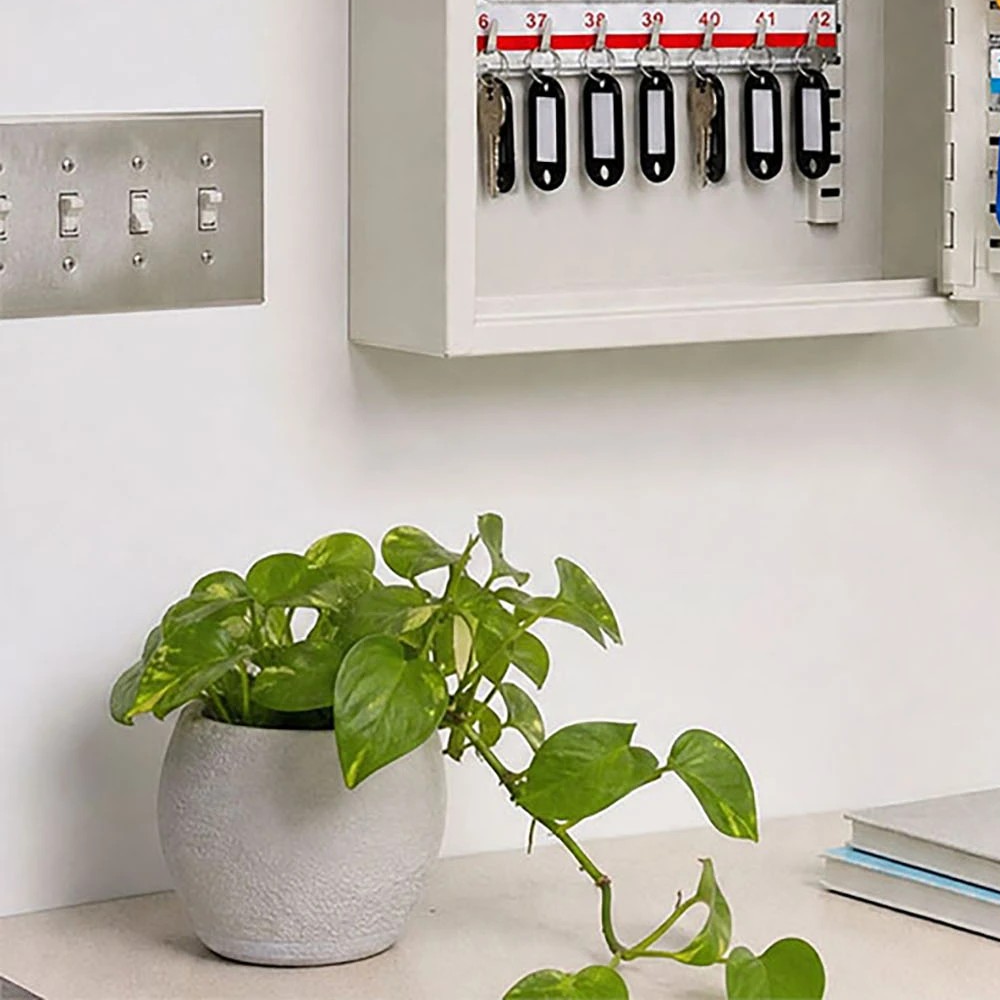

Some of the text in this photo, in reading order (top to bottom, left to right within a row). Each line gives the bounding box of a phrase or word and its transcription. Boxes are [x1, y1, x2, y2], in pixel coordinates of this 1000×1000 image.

[525, 13, 548, 29] 37
[584, 12, 606, 28] 38
[699, 11, 721, 27] 40
